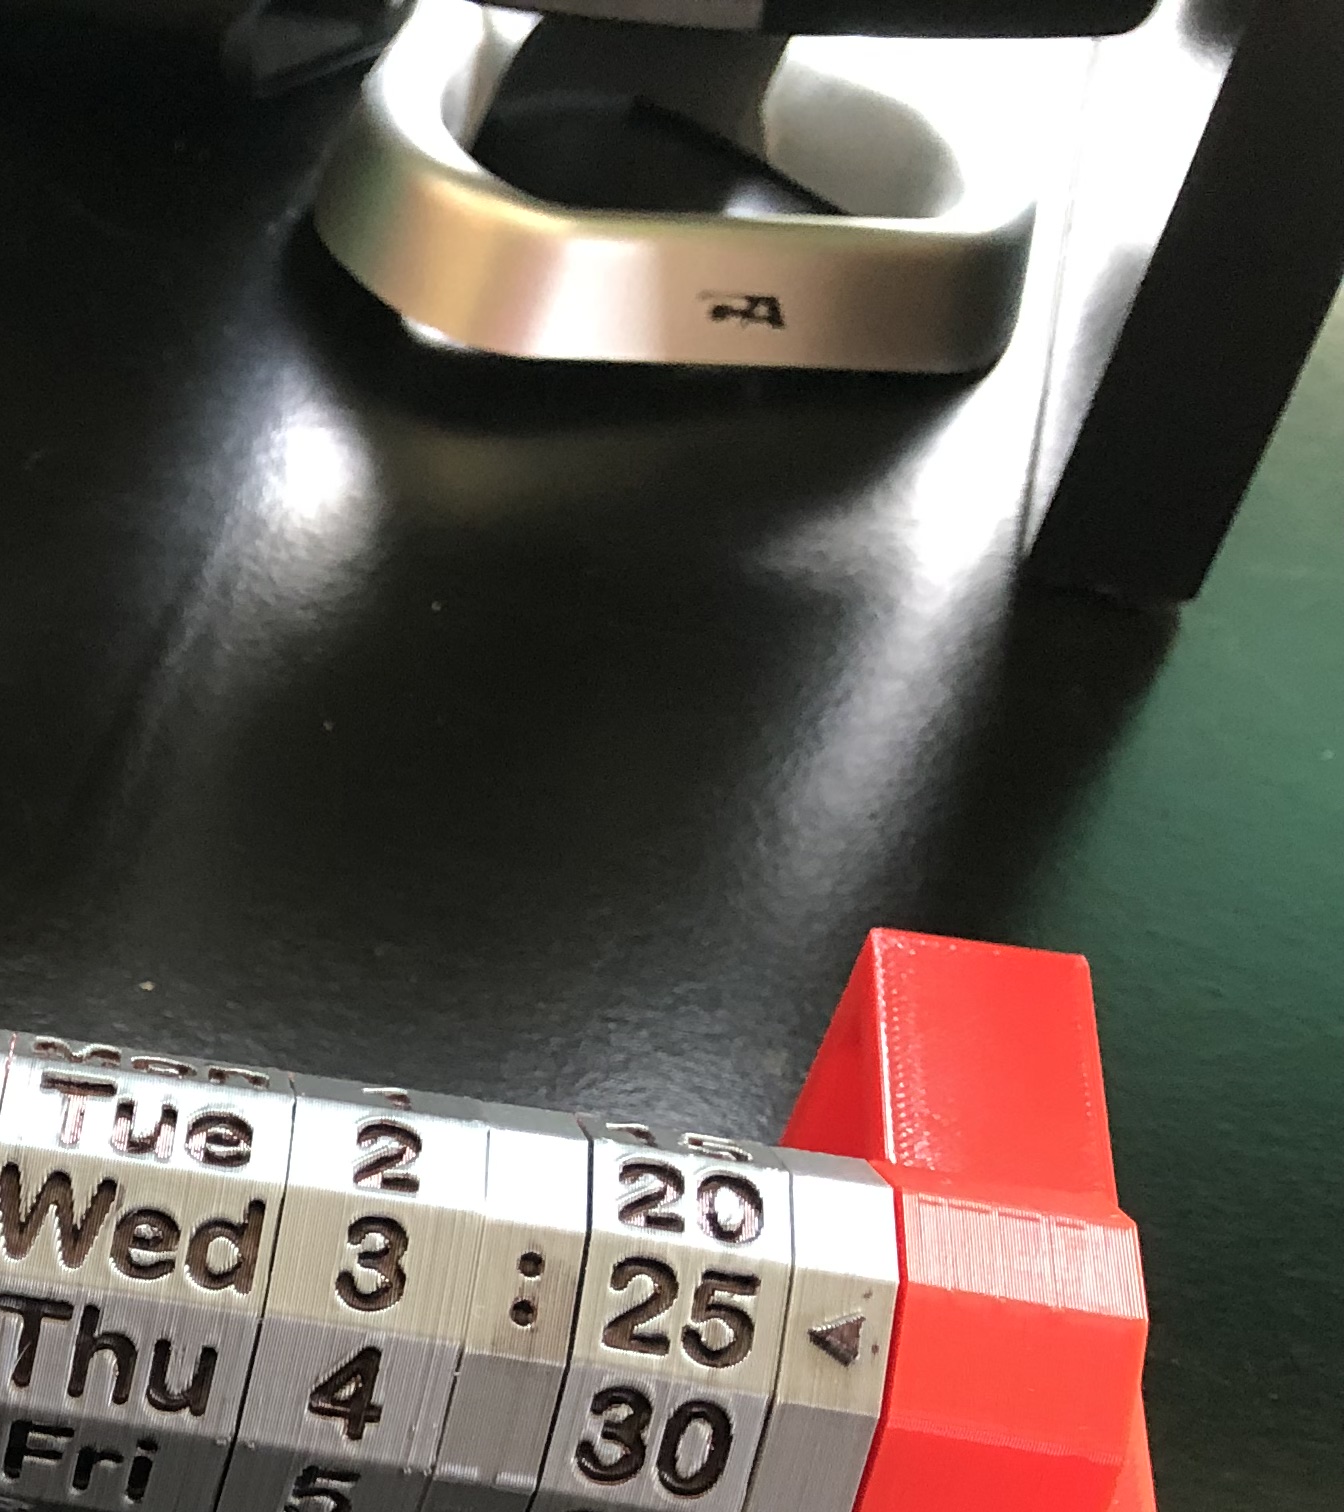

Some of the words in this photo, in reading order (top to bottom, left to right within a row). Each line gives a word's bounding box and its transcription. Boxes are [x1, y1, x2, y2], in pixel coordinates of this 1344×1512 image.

[38, 1071, 255, 1169] Tue
[352, 1118, 424, 1195] 2
[615, 1158, 765, 1245] 20
[333, 1214, 411, 1313] 3
[601, 1254, 762, 1370] 25
[0, 1418, 160, 1503] Fri
[307, 1344, 383, 1440] 4
[574, 1384, 736, 1501] 30
